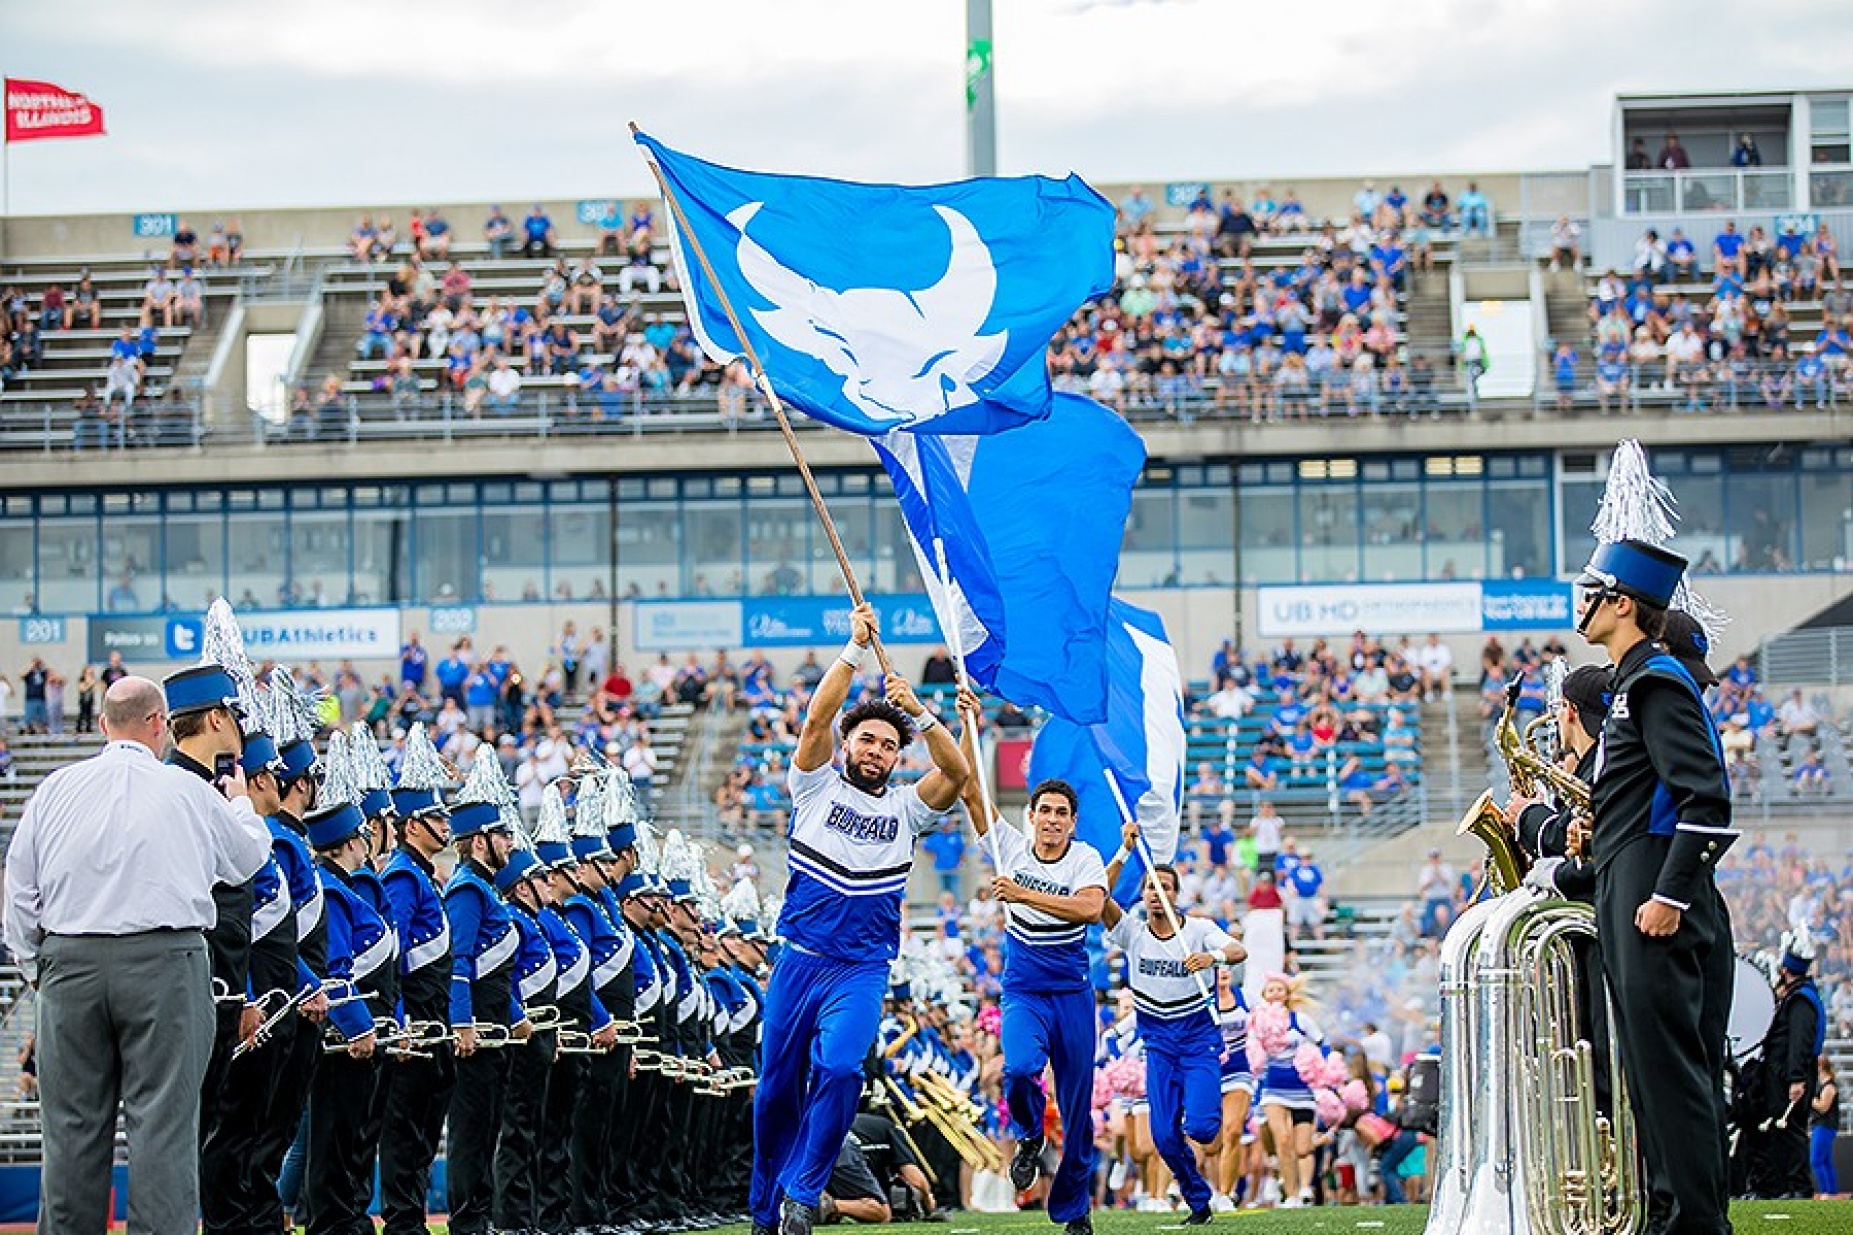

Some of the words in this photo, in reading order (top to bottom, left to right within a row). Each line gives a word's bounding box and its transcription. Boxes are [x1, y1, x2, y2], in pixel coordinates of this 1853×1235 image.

[140, 214, 171, 235] 301
[1274, 599, 1311, 622] UB
[26, 619, 60, 642] 201
[824, 800, 899, 844] BUFFALO
